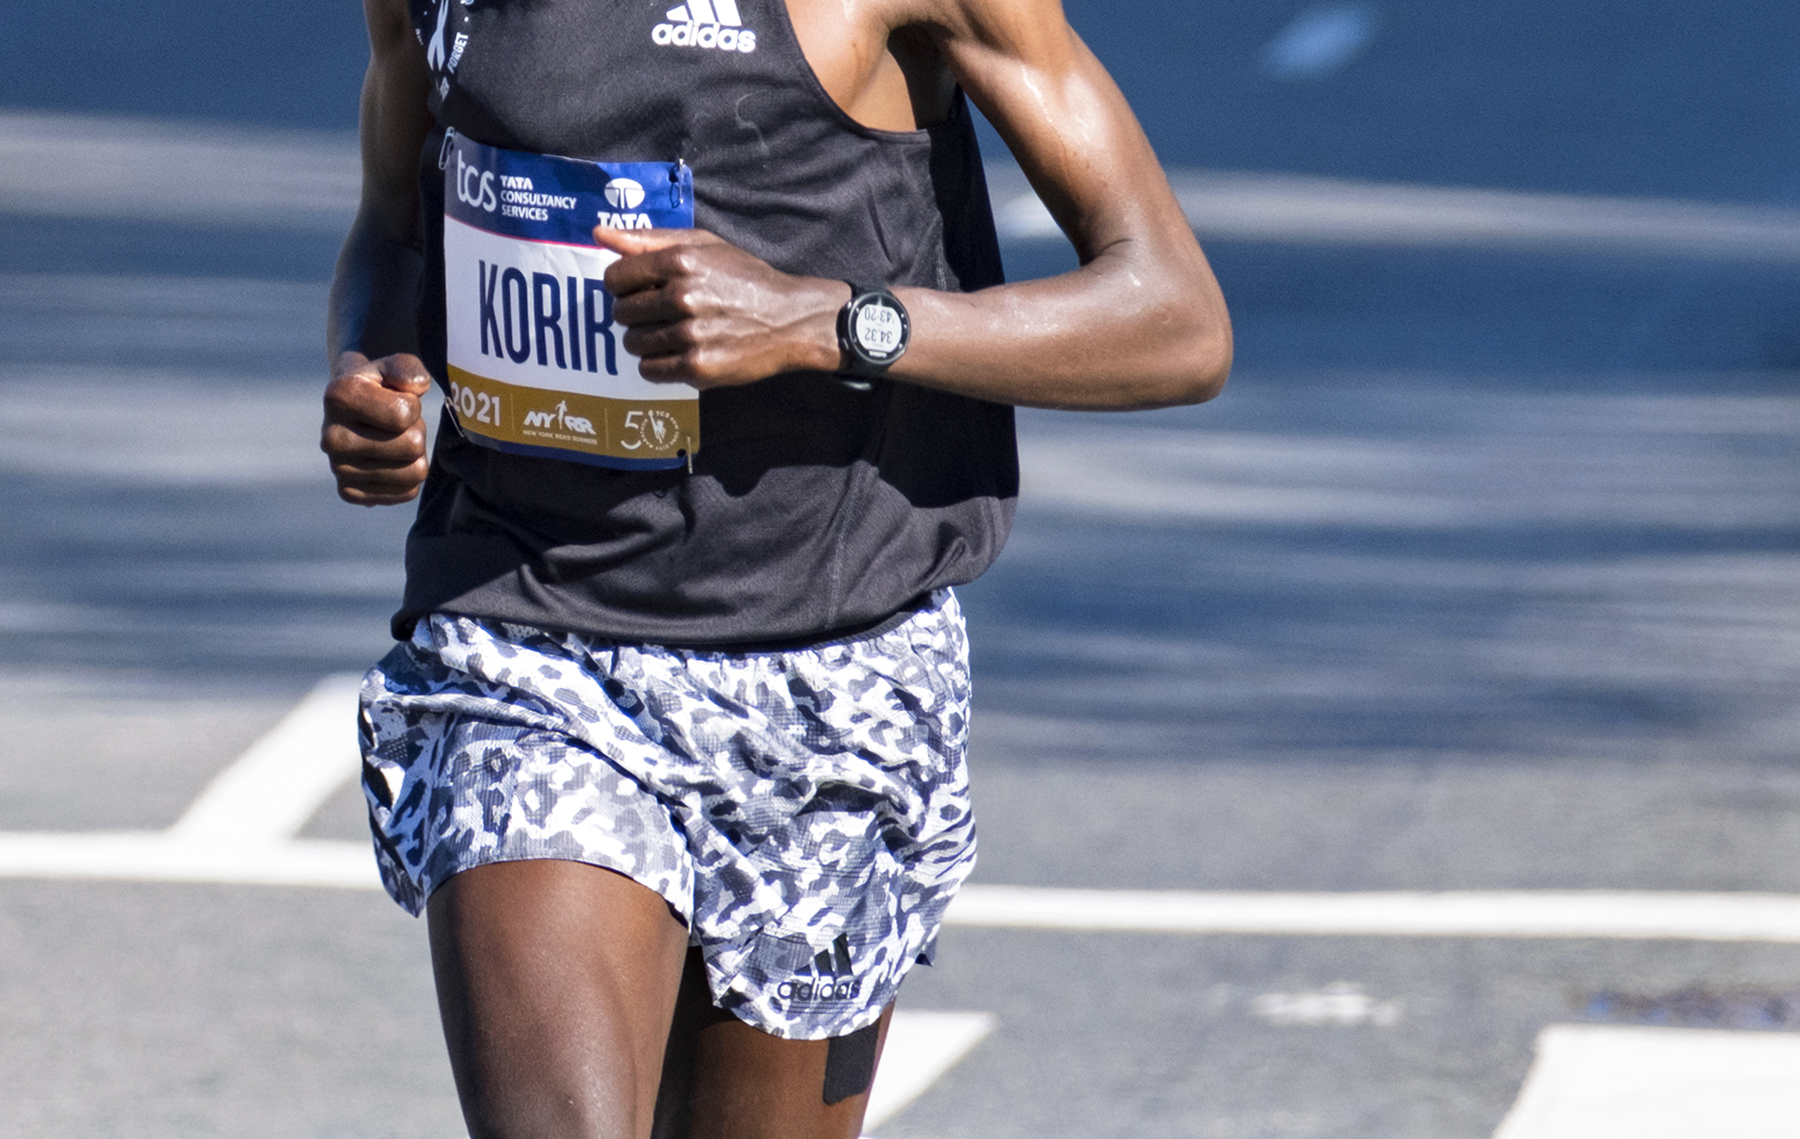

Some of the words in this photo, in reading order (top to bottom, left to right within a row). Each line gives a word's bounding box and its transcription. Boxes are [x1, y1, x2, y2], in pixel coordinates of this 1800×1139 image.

[651, 21, 757, 54] adidas
[447, 31, 469, 75] FORGET
[457, 149, 497, 212] tcs
[500, 175, 534, 191] TATA
[500, 189, 578, 210] CONSULTANCY
[501, 204, 549, 222] SERVICES
[597, 212, 653, 230] TATA
[478, 259, 619, 376] KORIR
[450, 381, 501, 427] 2021
[777, 975, 862, 1002] adidas
